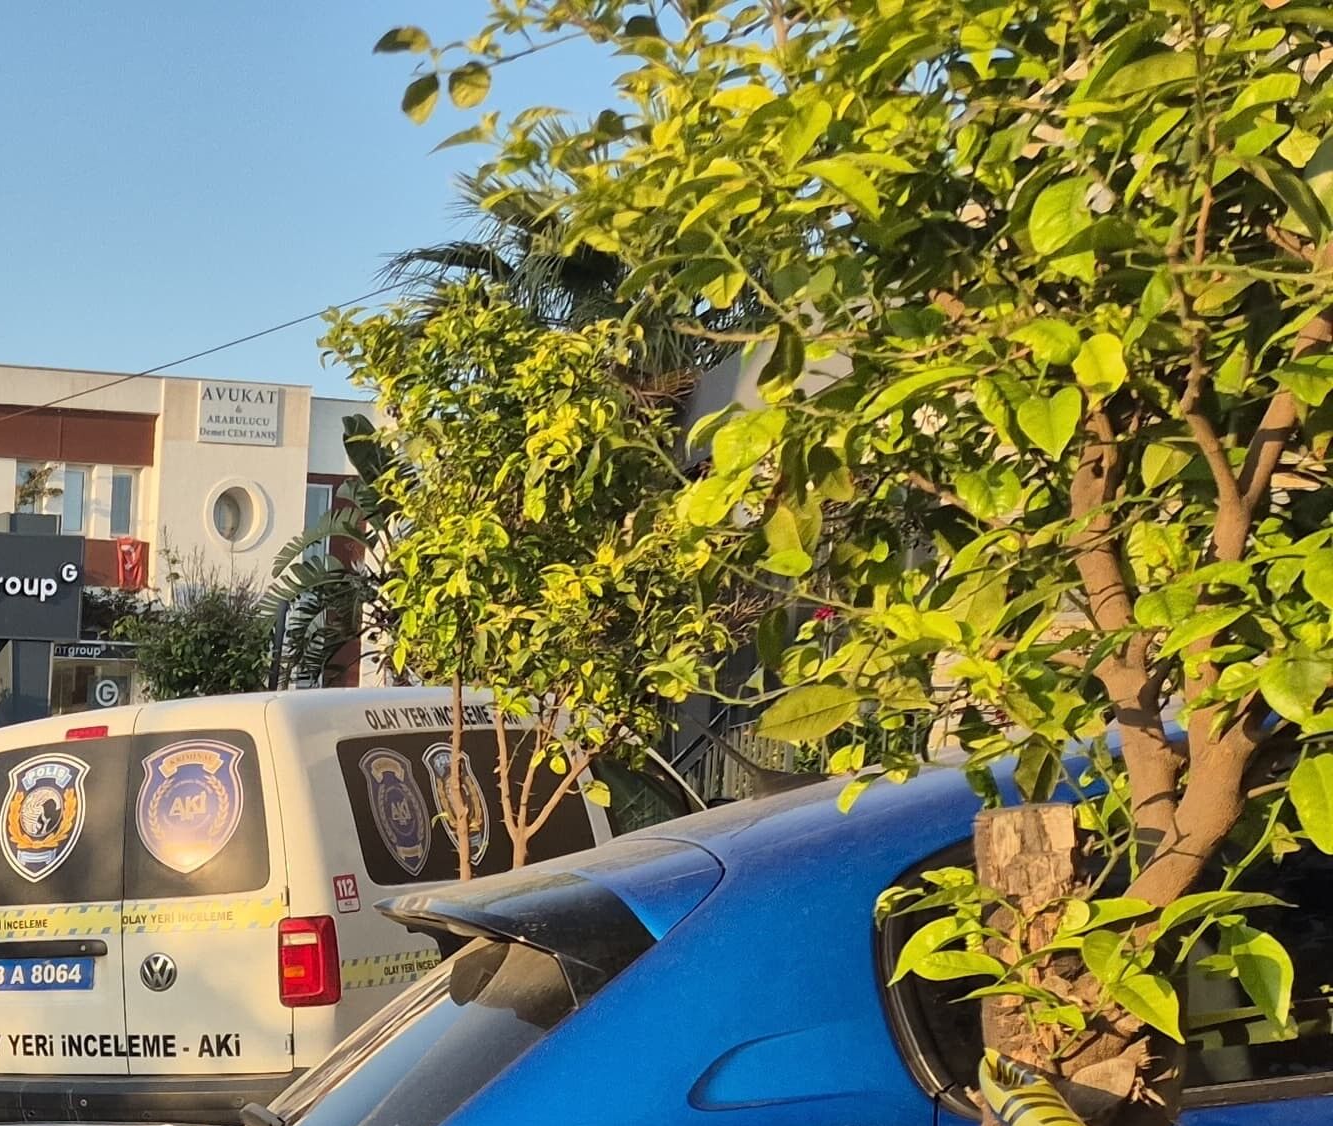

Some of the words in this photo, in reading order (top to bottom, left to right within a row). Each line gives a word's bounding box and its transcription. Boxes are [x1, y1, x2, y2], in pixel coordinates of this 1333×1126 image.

[201, 387, 277, 404] AVUKAT
[207, 415, 270, 426] ARABULUCU
[200, 427, 225, 436] Demet
[227, 429, 247, 438] CEM
[364, 709, 401, 730] OLAY
[336, 879, 356, 898] 112
[122, 914, 147, 925] OLAY
[10, 965, 25, 985] A
[30, 963, 82, 985] 8064
